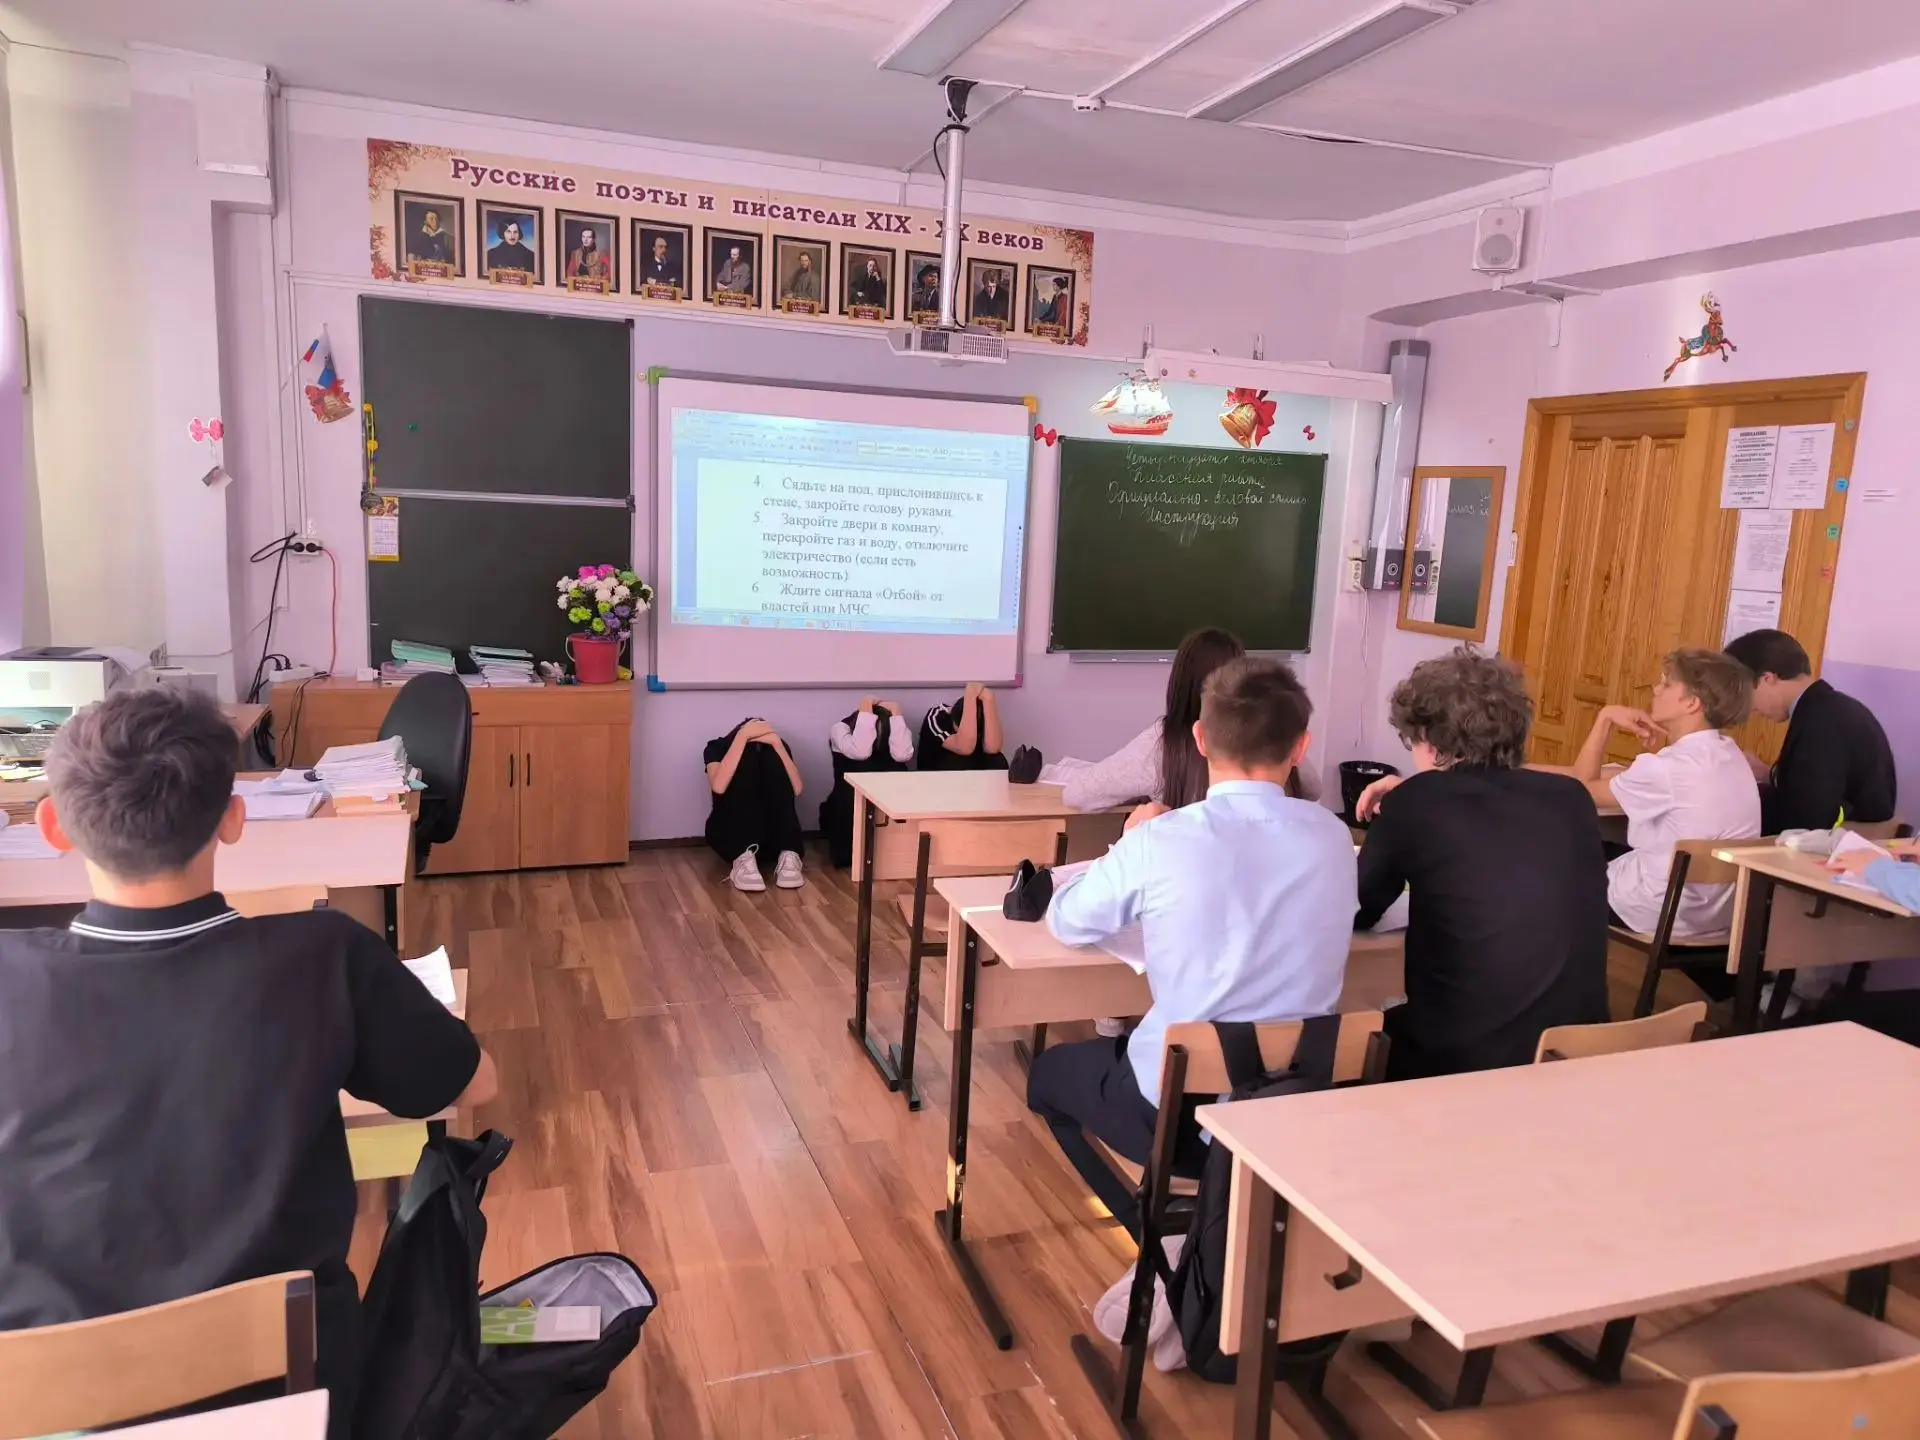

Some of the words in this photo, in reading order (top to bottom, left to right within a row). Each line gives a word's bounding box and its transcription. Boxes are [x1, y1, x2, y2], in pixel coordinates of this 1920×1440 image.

[451, 158, 576, 193] Русские
[596, 181, 687, 207] поэты
[698, 193, 715, 210] и
[732, 200, 857, 228] писатели
[865, 211, 911, 234] XIX
[977, 229, 1044, 251] веков
[782, 477, 827, 493] Сядьте
[830, 484, 844, 493] на
[878, 487, 973, 502] прислонившись
[976, 492, 984, 502] к
[762, 498, 801, 509] стене,
[804, 499, 859, 516] закройте
[863, 504, 904, 517] голову
[782, 513, 838, 532] Закройте
[841, 518, 878, 532] двери
[881, 522, 888, 531] в
[891, 522, 944, 536] комнату,
[761, 531, 834, 546] перекройте
[837, 536, 856, 546] газ
[859, 538, 868, 547] и
[870, 538, 902, 550] воду,
[905, 539, 969, 552] отключите
[762, 549, 852, 566] электричество
[855, 555, 888, 567] (если
[891, 557, 916, 567] есть
[762, 567, 850, 581] возможность)
[780, 583, 822, 598] Ждите
[824, 587, 872, 599] сигнала
[875, 589, 926, 601] «Отбой»
[930, 593, 944, 602] от
[761, 601, 810, 614] властей
[812, 604, 836, 614] или
